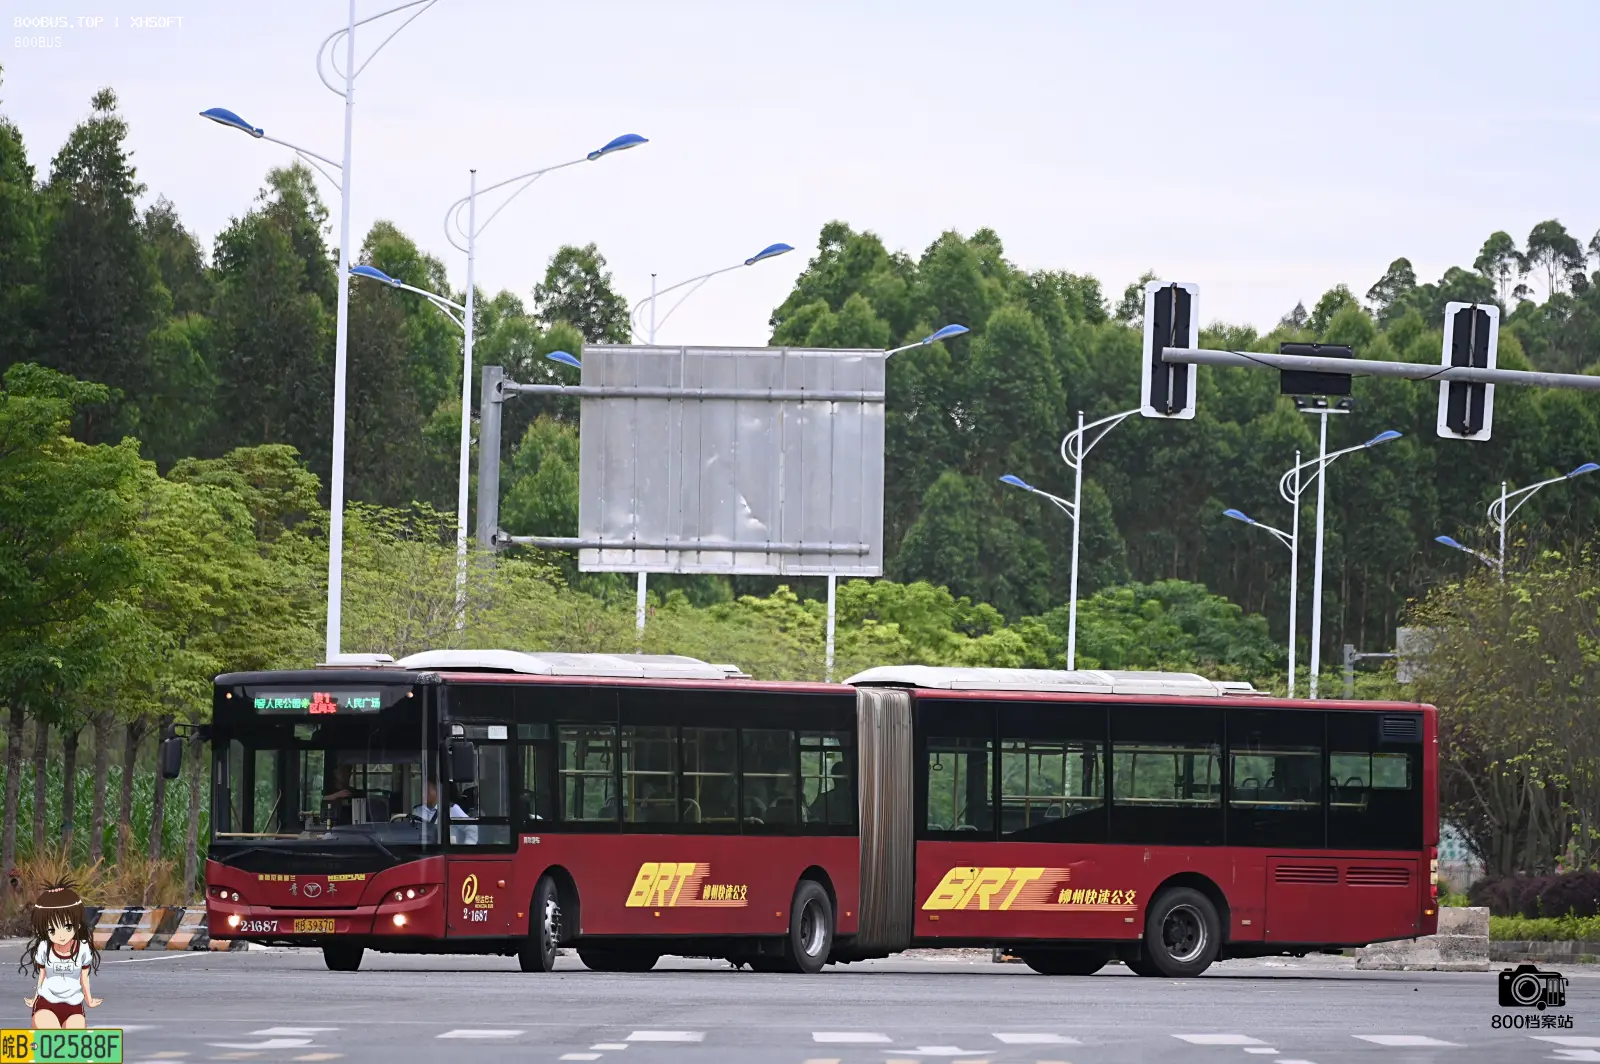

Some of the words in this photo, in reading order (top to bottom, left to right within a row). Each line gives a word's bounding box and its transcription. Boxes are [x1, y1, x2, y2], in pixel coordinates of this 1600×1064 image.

[345, 697, 381, 709] 人民广场
[625, 862, 696, 907] BRT
[702, 884, 748, 900] 柳州快速公交
[921, 867, 1046, 910] BRT
[1057, 888, 1137, 905] 柳州快速公交
